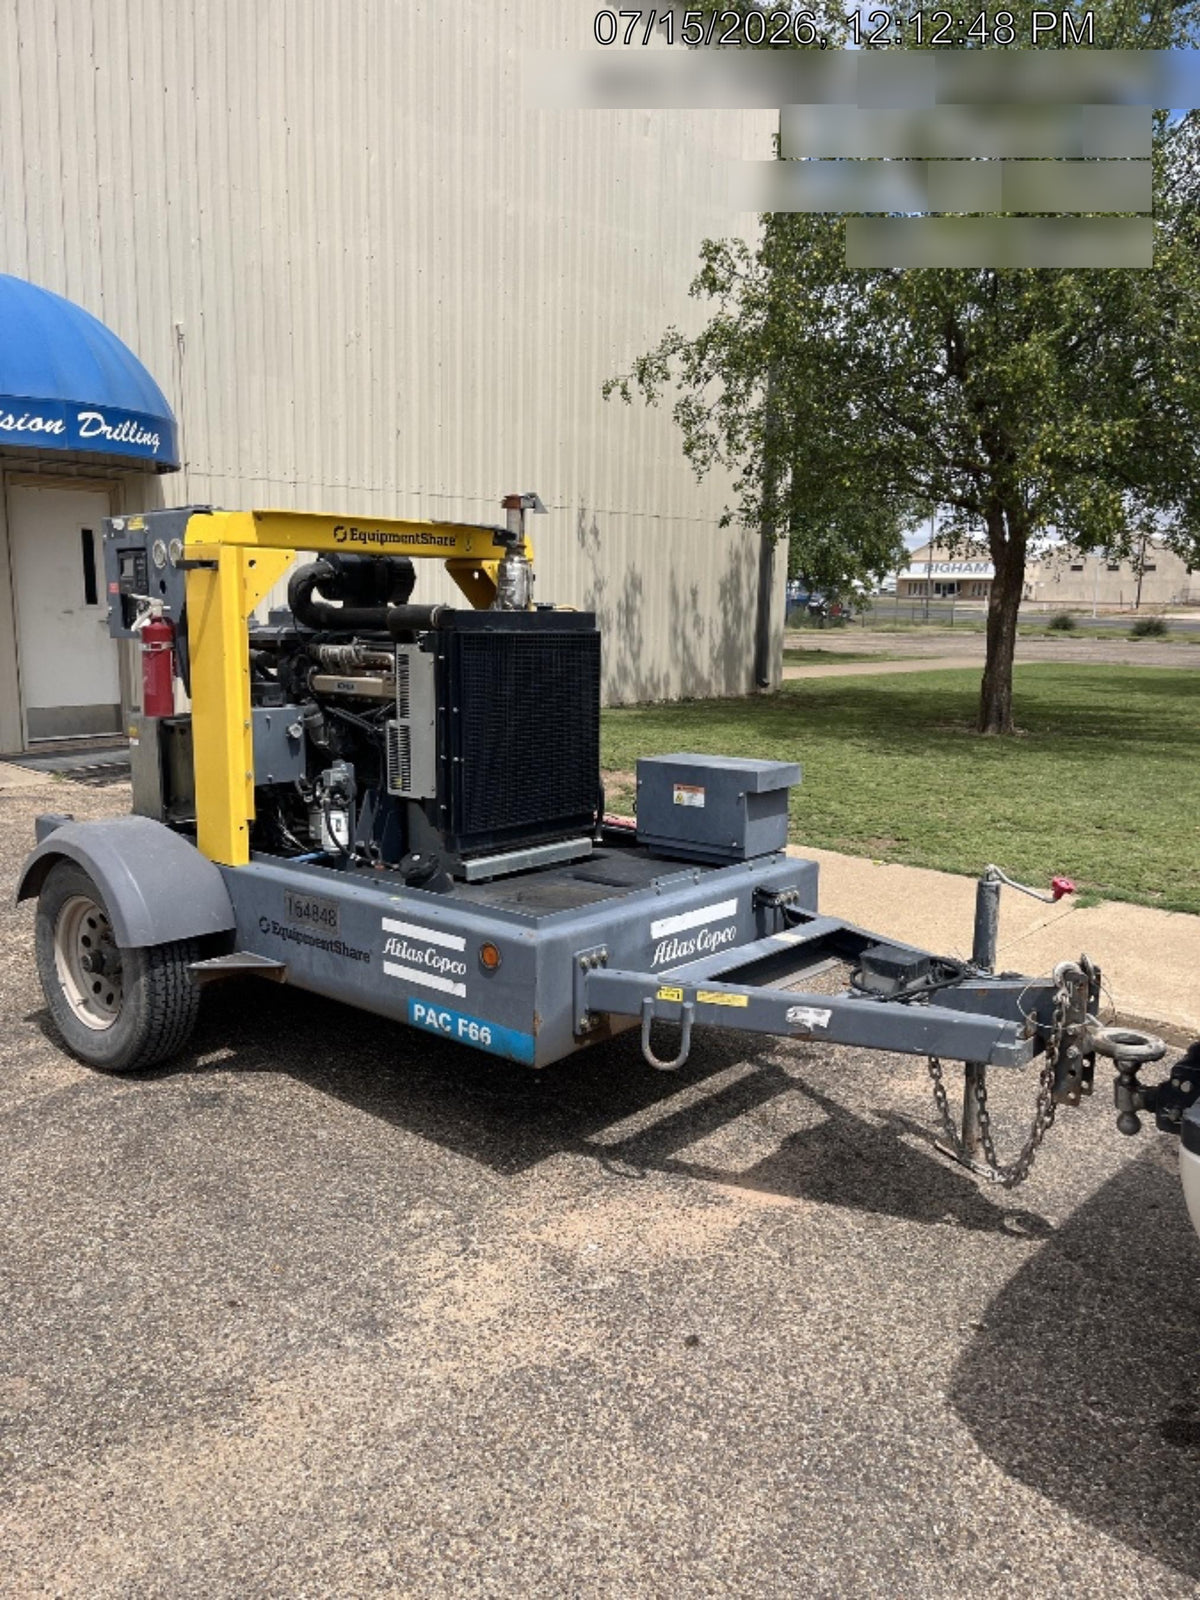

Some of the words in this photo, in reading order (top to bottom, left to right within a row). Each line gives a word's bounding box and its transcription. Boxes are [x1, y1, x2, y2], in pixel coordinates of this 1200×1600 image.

[77, 412, 161, 454] Drilling
[349, 527, 456, 546] EquipmentShare
[924, 563, 989, 573] BIGHAM
[271, 920, 371, 964] EquipmentShare
[382, 937, 424, 964] Atlas
[424, 948, 467, 976] Copco
[650, 938, 696, 968] Atlas
[696, 925, 737, 952] Copco
[413, 1003, 452, 1032] PAC
[458, 1019, 492, 1046] F66
